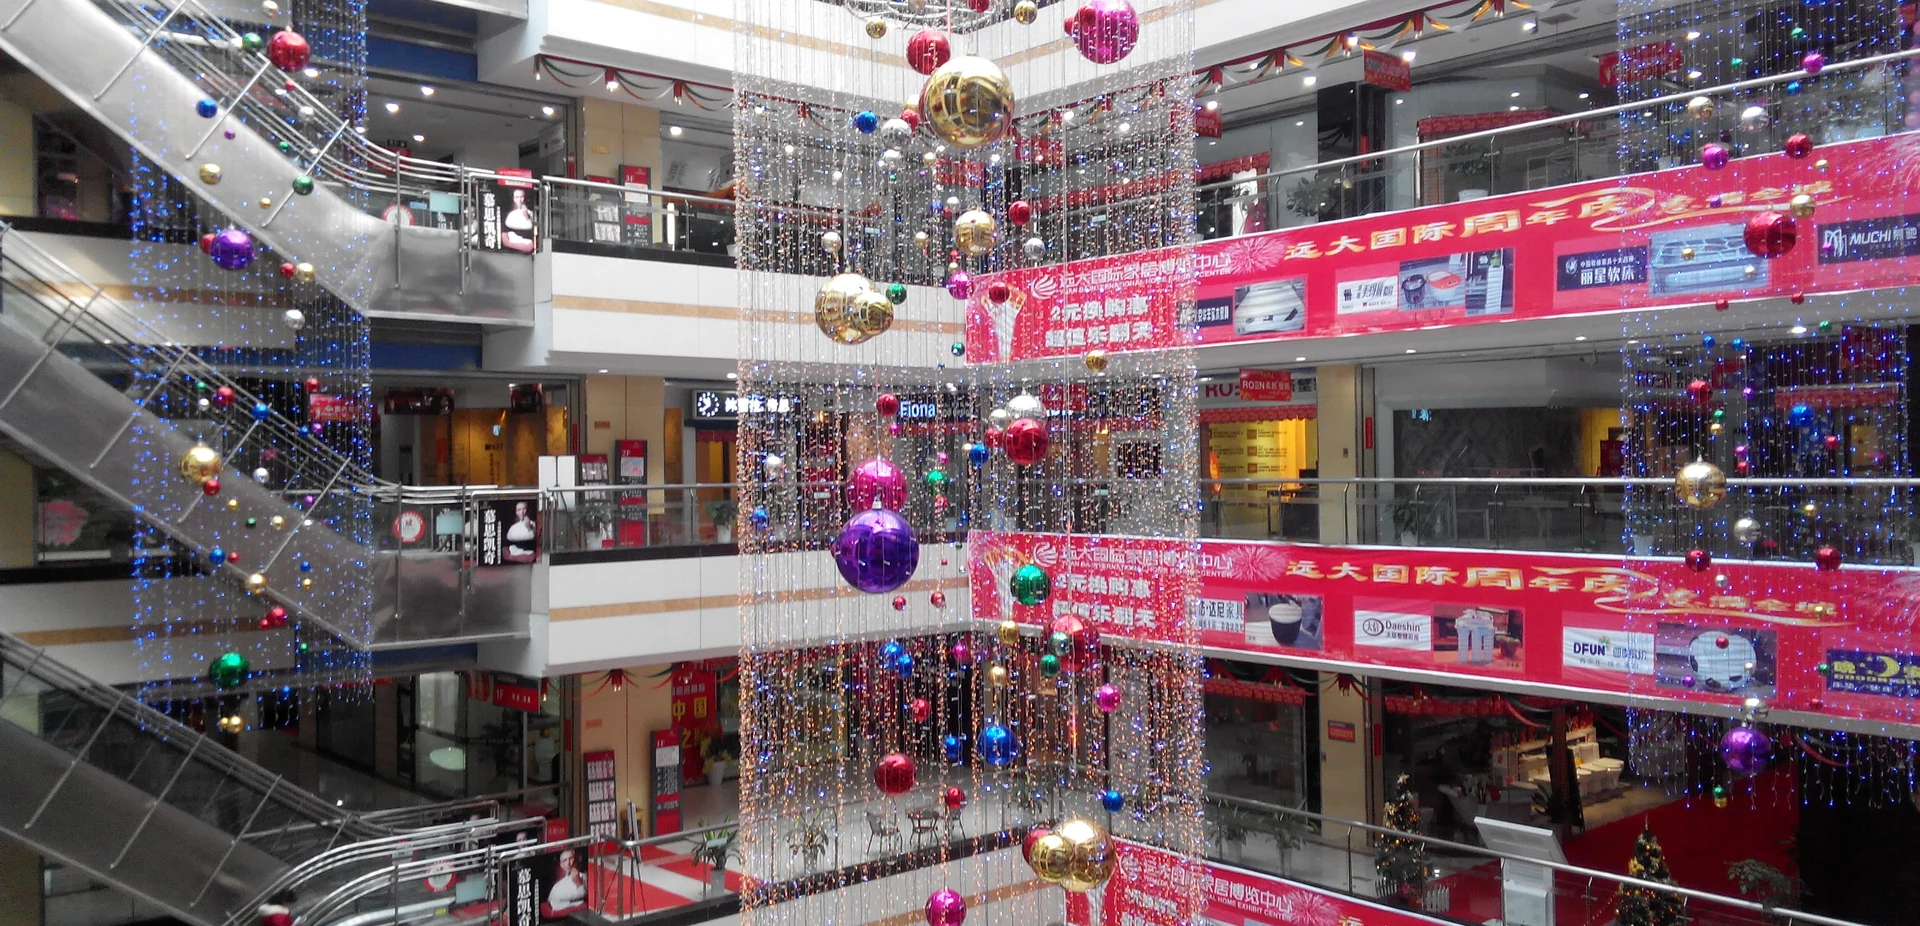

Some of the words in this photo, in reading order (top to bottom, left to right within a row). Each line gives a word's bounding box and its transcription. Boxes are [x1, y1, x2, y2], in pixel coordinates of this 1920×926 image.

[1284, 195, 1631, 261] 远大国际周年庆
[1849, 229, 1892, 246] MUCHI
[1199, 266, 1231, 278] CENTER
[1581, 266, 1635, 286] 丽星软床
[900, 401, 936, 418] Fiona
[1201, 568, 1233, 578] CENTER
[1286, 560, 1630, 594] 远大国际周年庆
[1386, 620, 1420, 632] Daeshin
[1573, 642, 1606, 656] DFUN
[673, 696, 707, 721] 中国
[1237, 901, 1262, 915] EXHIBIT
